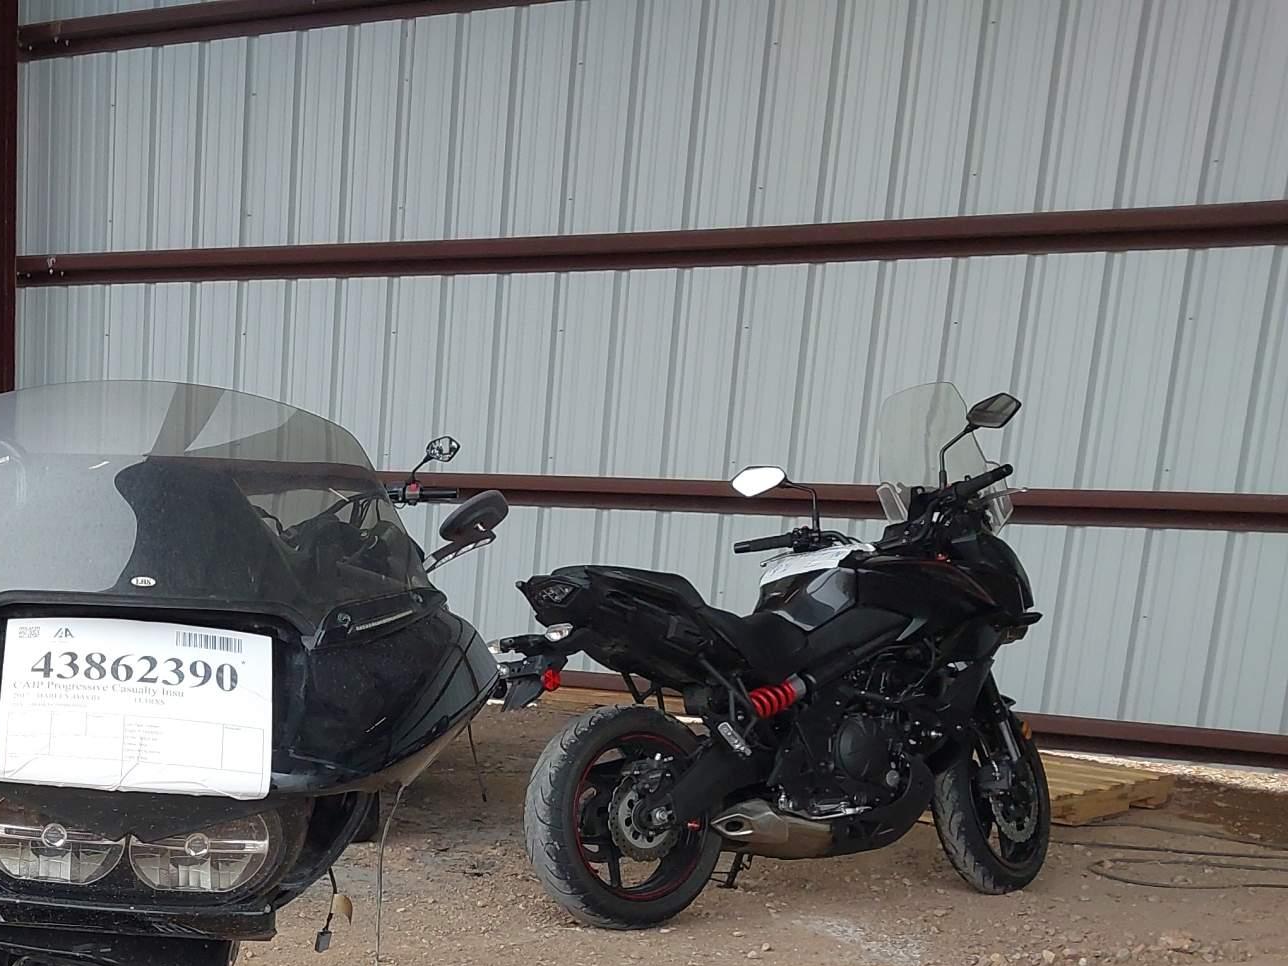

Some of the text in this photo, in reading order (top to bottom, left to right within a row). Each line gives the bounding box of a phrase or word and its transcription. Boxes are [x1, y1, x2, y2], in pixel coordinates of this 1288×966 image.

[30, 651, 238, 692] 43862390
[47, 681, 108, 692] Progressive
[111, 684, 156, 697] Casualty
[161, 687, 184, 697] Insu
